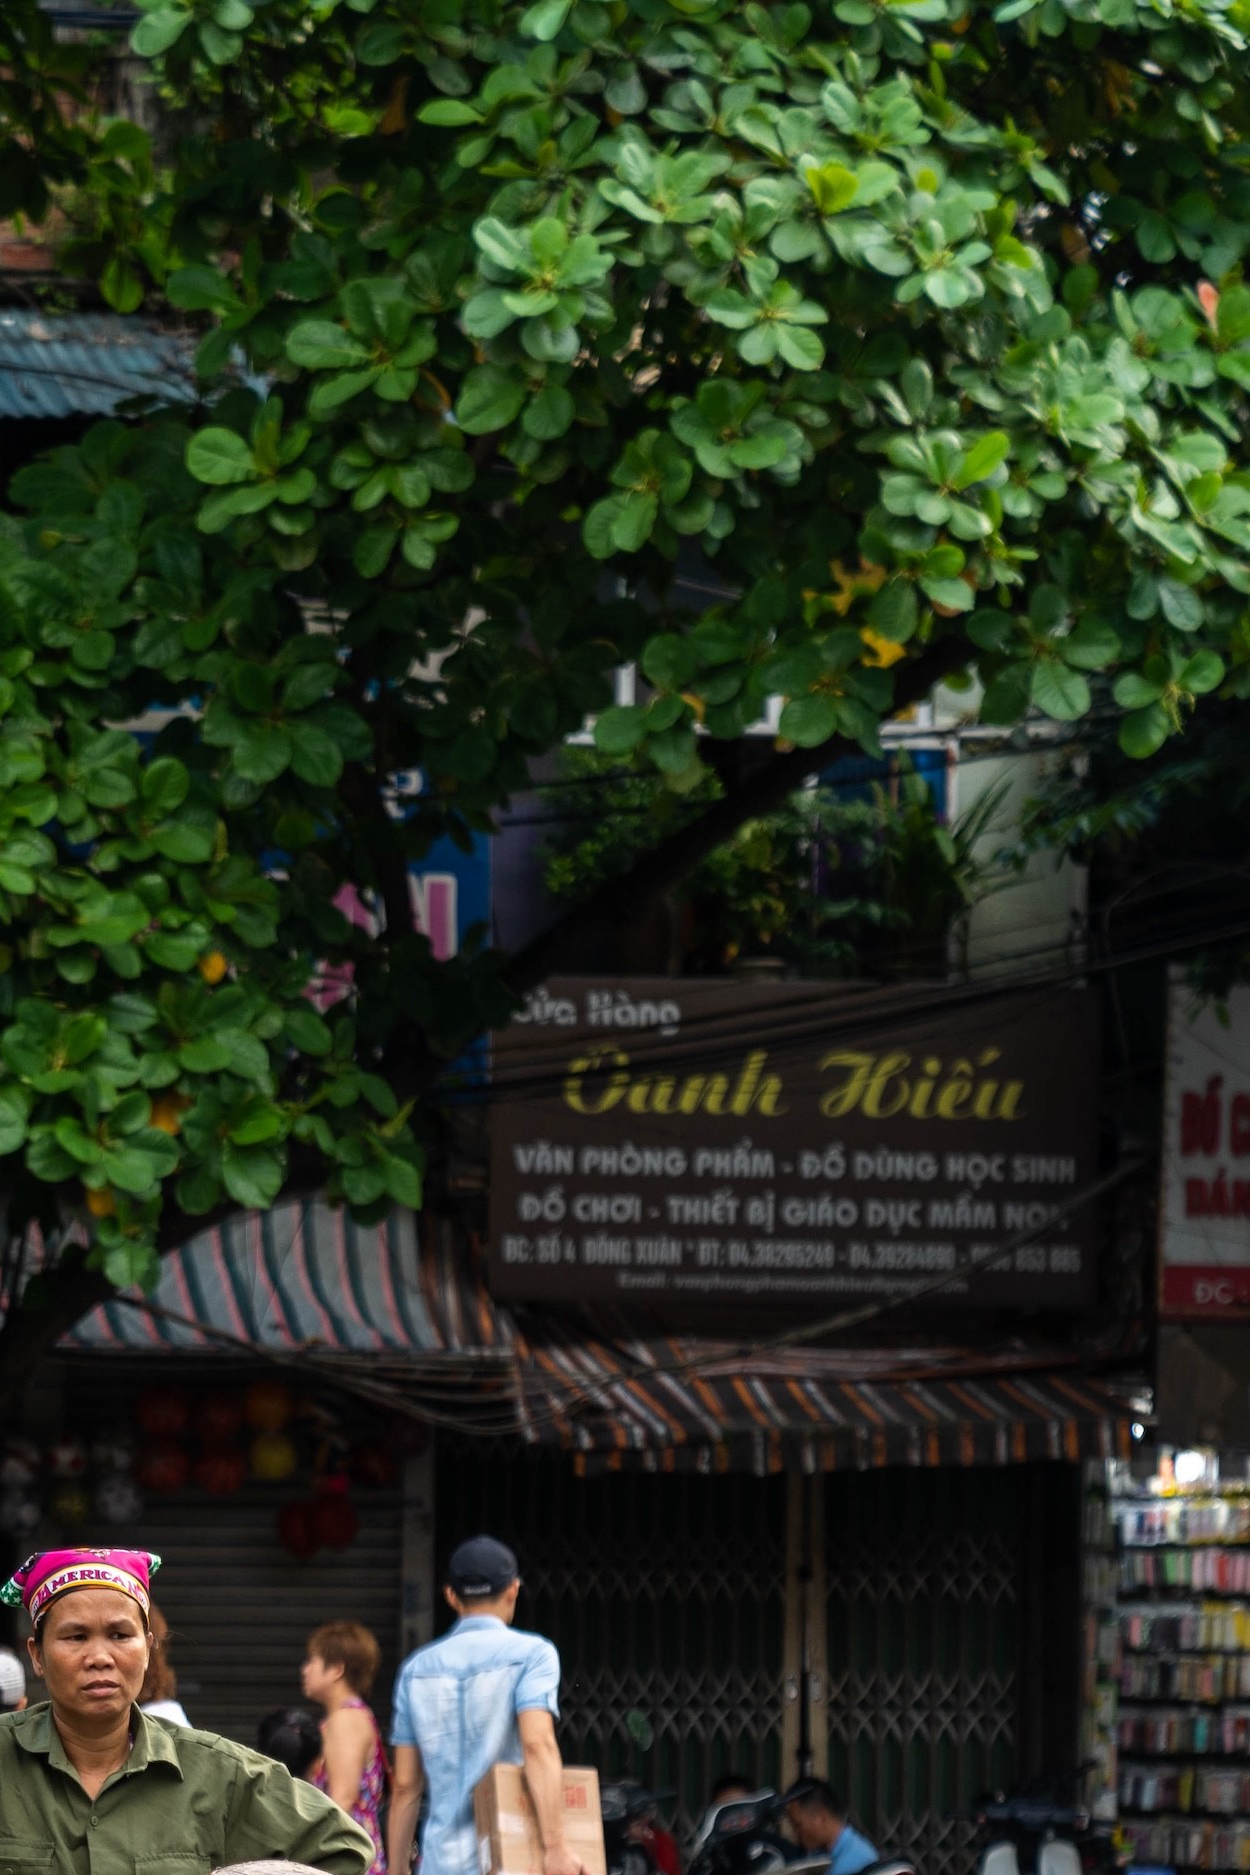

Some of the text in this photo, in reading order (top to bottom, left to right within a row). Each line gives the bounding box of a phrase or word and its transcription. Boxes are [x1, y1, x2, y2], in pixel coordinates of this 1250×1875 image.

[586, 988, 681, 1037] Hàng
[819, 1046, 1028, 1121] Hiếu
[513, 1139, 575, 1175] VĂN
[579, 1141, 688, 1178] PHÒNG
[694, 1136, 775, 1179] PHẨM
[852, 1144, 938, 1182] DÙNG
[944, 1151, 1006, 1190] HỌC
[1011, 1154, 1077, 1184] SINH
[572, 1192, 642, 1224] CHƠI
[666, 1185, 740, 1226] THIẾT
[745, 1187, 776, 1234] BỊ
[781, 1190, 859, 1229] GIÁO
[864, 1198, 923, 1237] DỤC
